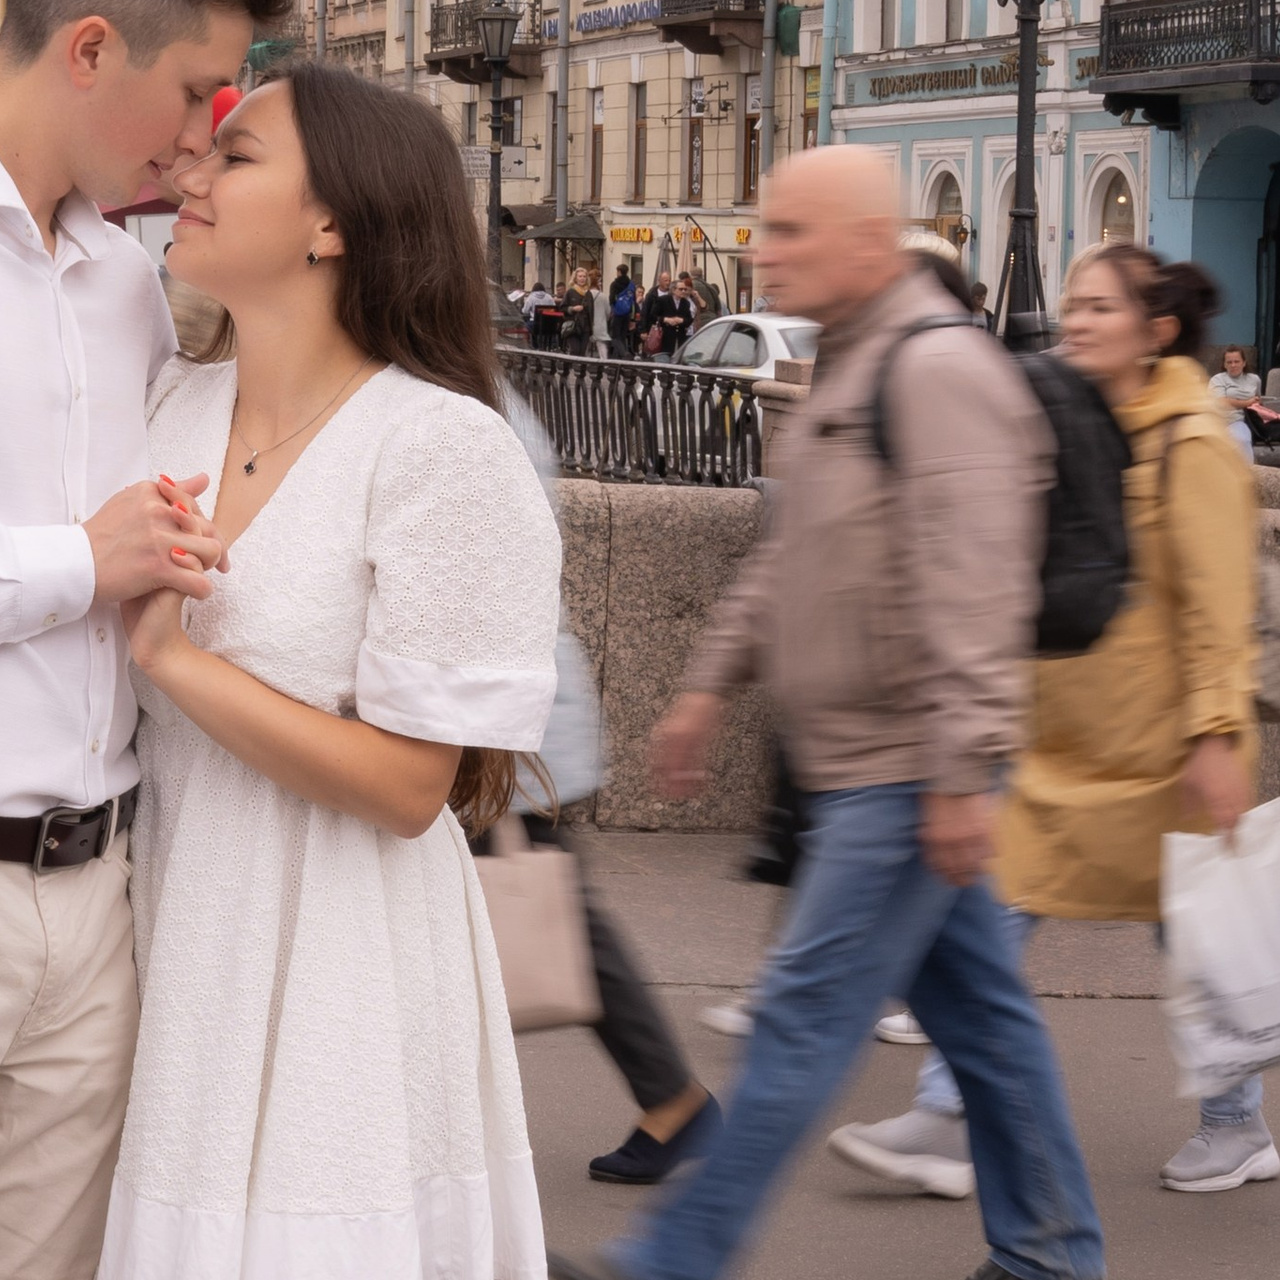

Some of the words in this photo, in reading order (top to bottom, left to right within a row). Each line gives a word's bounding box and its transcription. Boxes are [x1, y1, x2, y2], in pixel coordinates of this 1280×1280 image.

[541, 18, 559, 38] АВИ
[869, 63, 977, 100] ХУДОЖЕСТВЕННЫЙ
[736, 227, 751, 244] БАР
